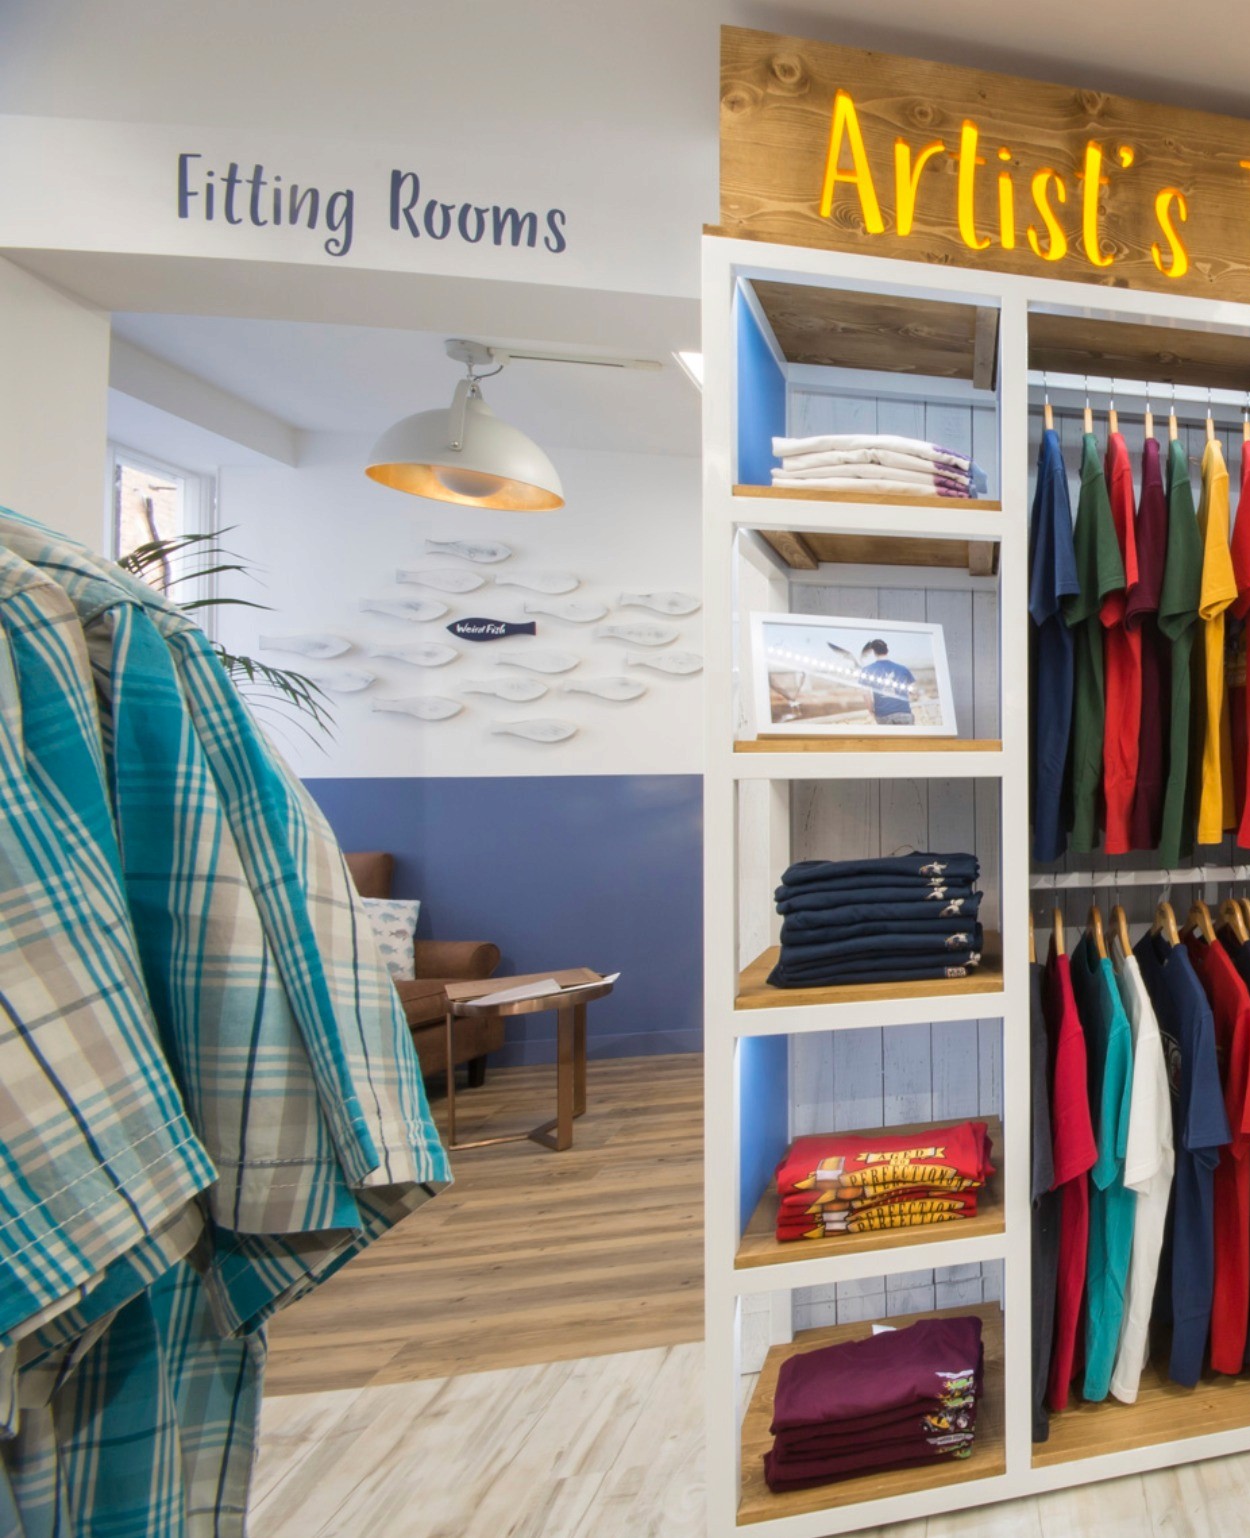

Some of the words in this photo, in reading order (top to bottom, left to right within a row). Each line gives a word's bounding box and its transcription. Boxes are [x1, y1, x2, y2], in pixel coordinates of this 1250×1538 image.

[177, 153, 354, 257] Fitting
[389, 168, 567, 253] Rooms
[819, 87, 1189, 278] Artist's
[455, 622, 485, 634] Weird
[848, 1165, 949, 1187] PERFECTION
